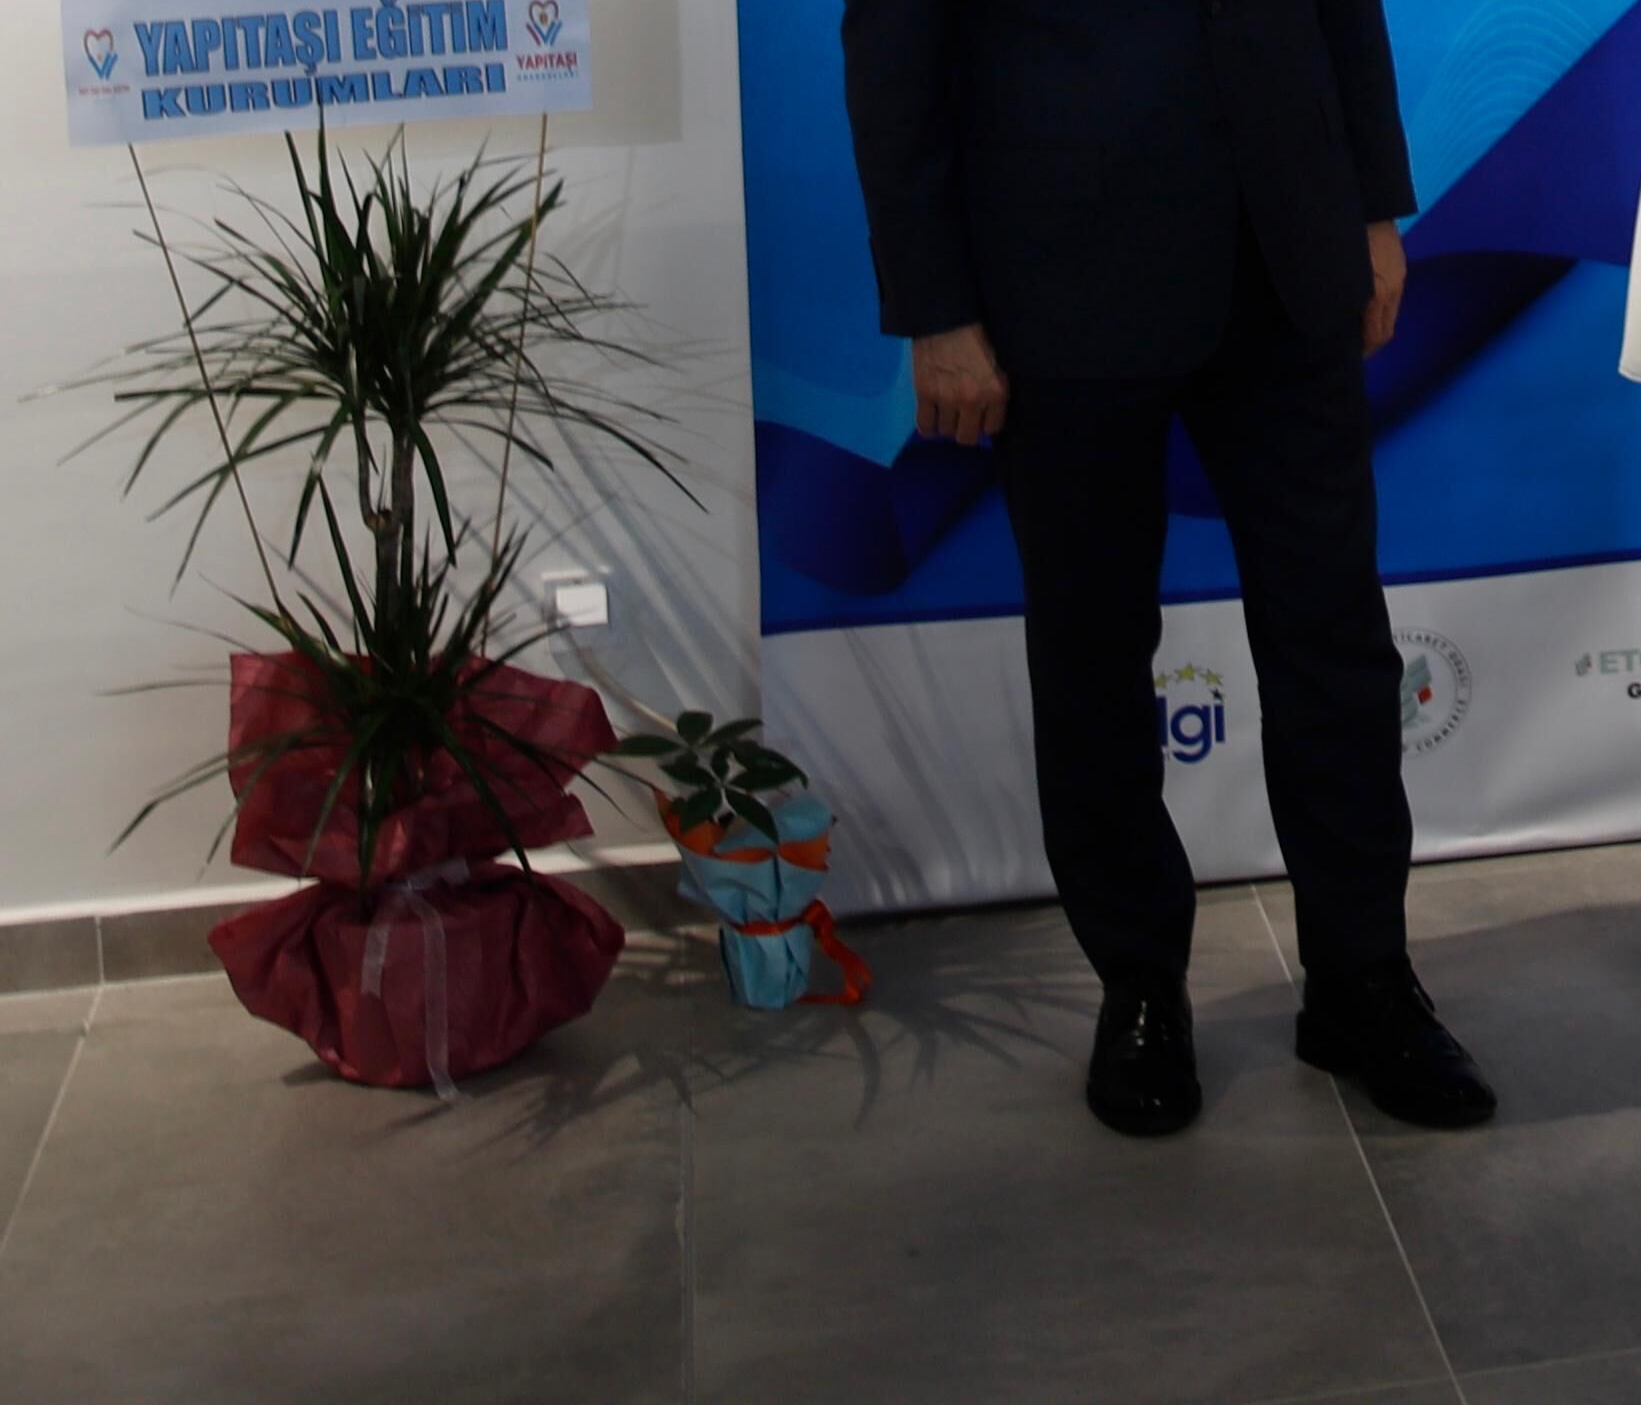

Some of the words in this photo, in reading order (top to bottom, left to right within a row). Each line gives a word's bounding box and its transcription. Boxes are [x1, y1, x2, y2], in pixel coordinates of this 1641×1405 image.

[133, 8, 341, 77] YAPITAŞI
[142, 61, 507, 121] KURUMLARI
[1156, 689, 1225, 764] lgi
